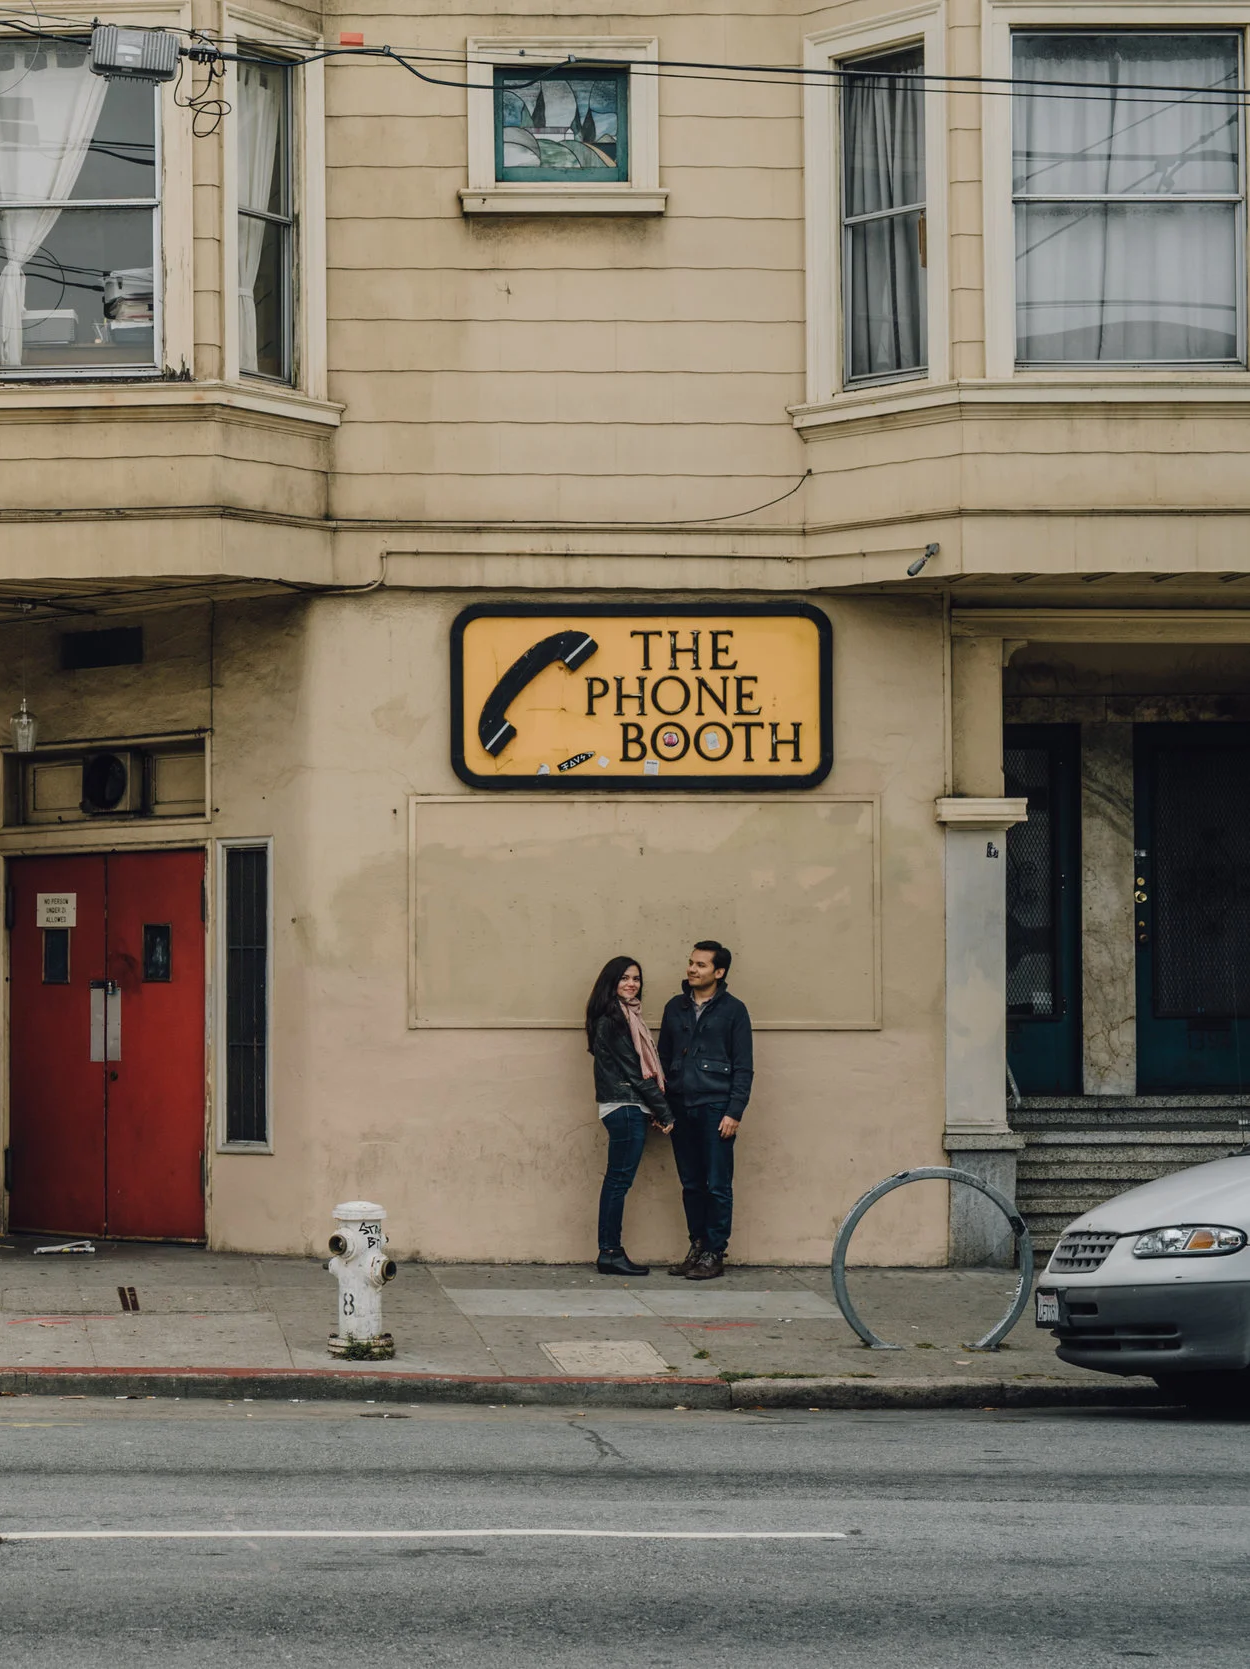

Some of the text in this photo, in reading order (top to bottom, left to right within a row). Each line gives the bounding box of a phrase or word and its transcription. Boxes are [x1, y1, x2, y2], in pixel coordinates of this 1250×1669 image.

[630, 630, 738, 670] THE
[584, 675, 763, 716] PHONE
[619, 721, 803, 762] BOOTH
